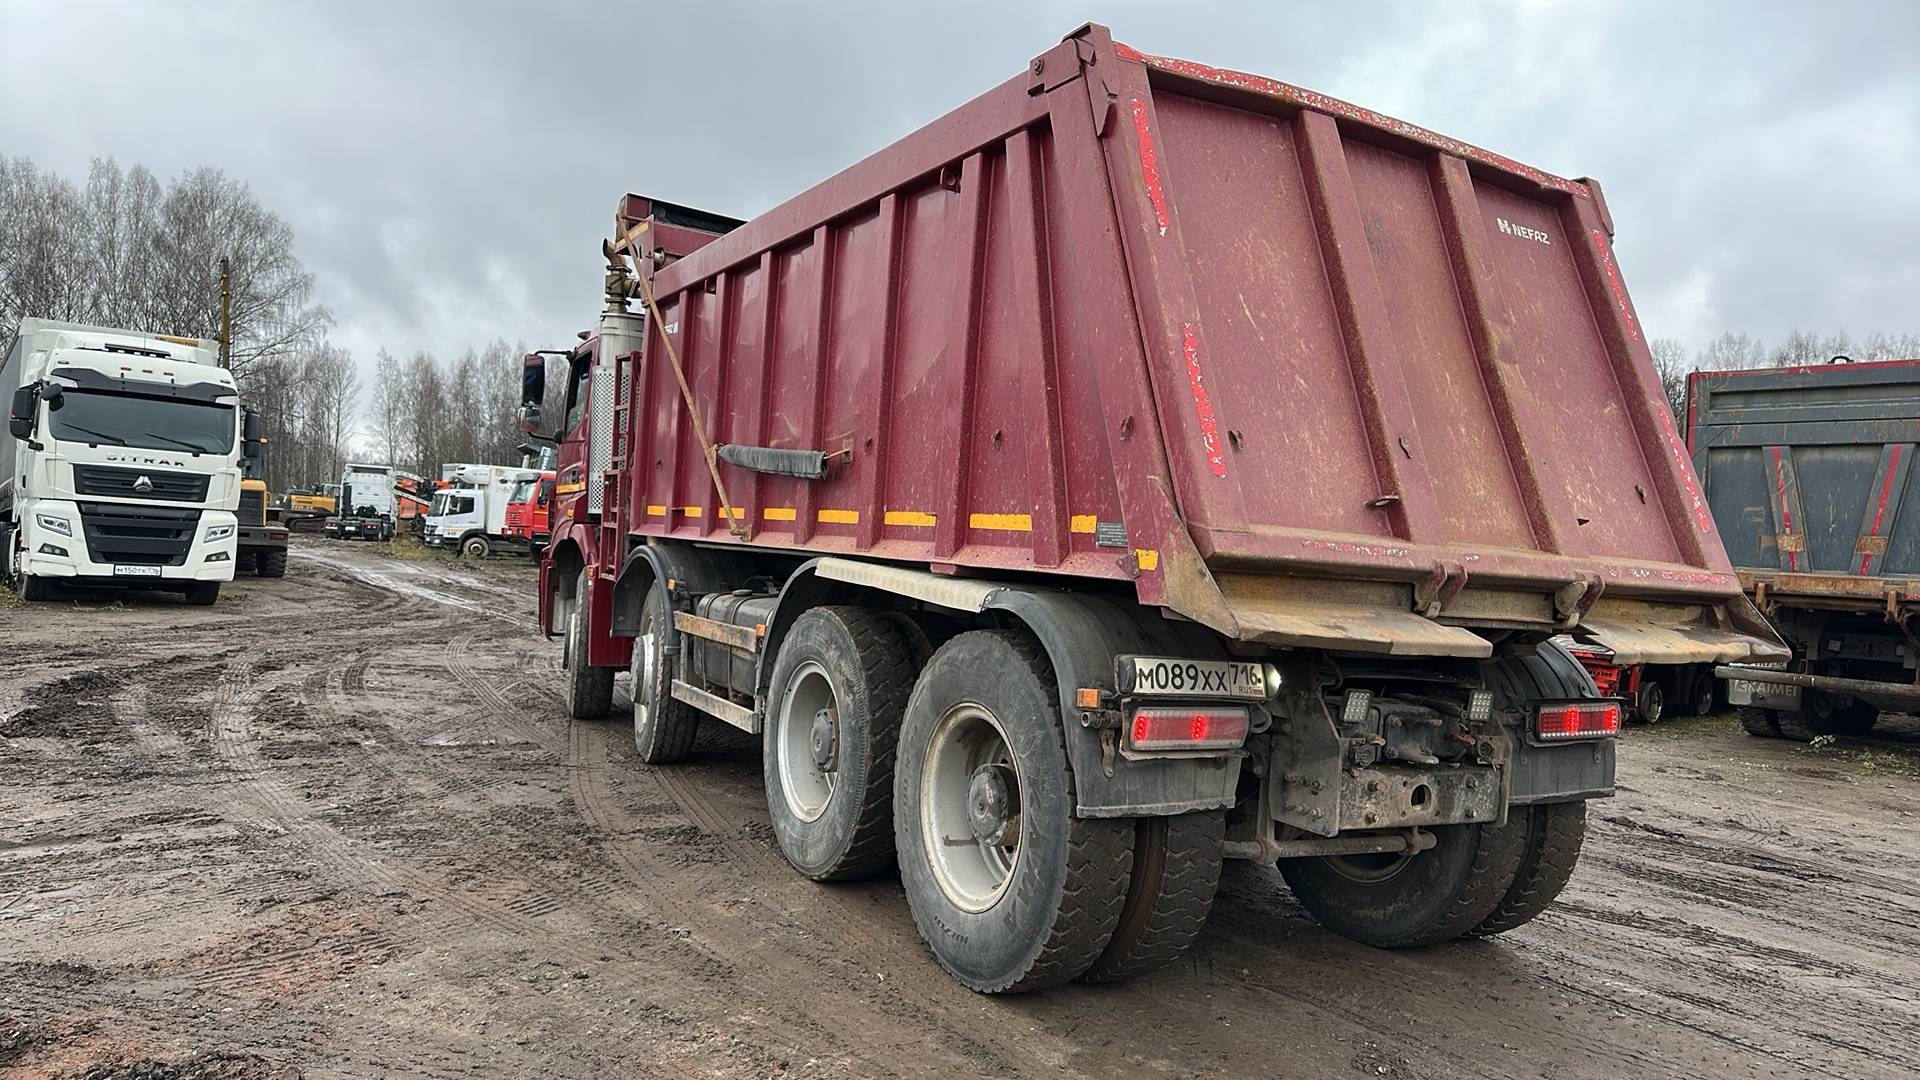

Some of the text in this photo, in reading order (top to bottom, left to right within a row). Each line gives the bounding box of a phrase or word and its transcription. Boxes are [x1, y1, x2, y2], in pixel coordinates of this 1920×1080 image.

[1511, 223, 1551, 245] NEFAZ
[1230, 664, 1258, 686] 716
[1239, 687, 1254, 695] RUS
